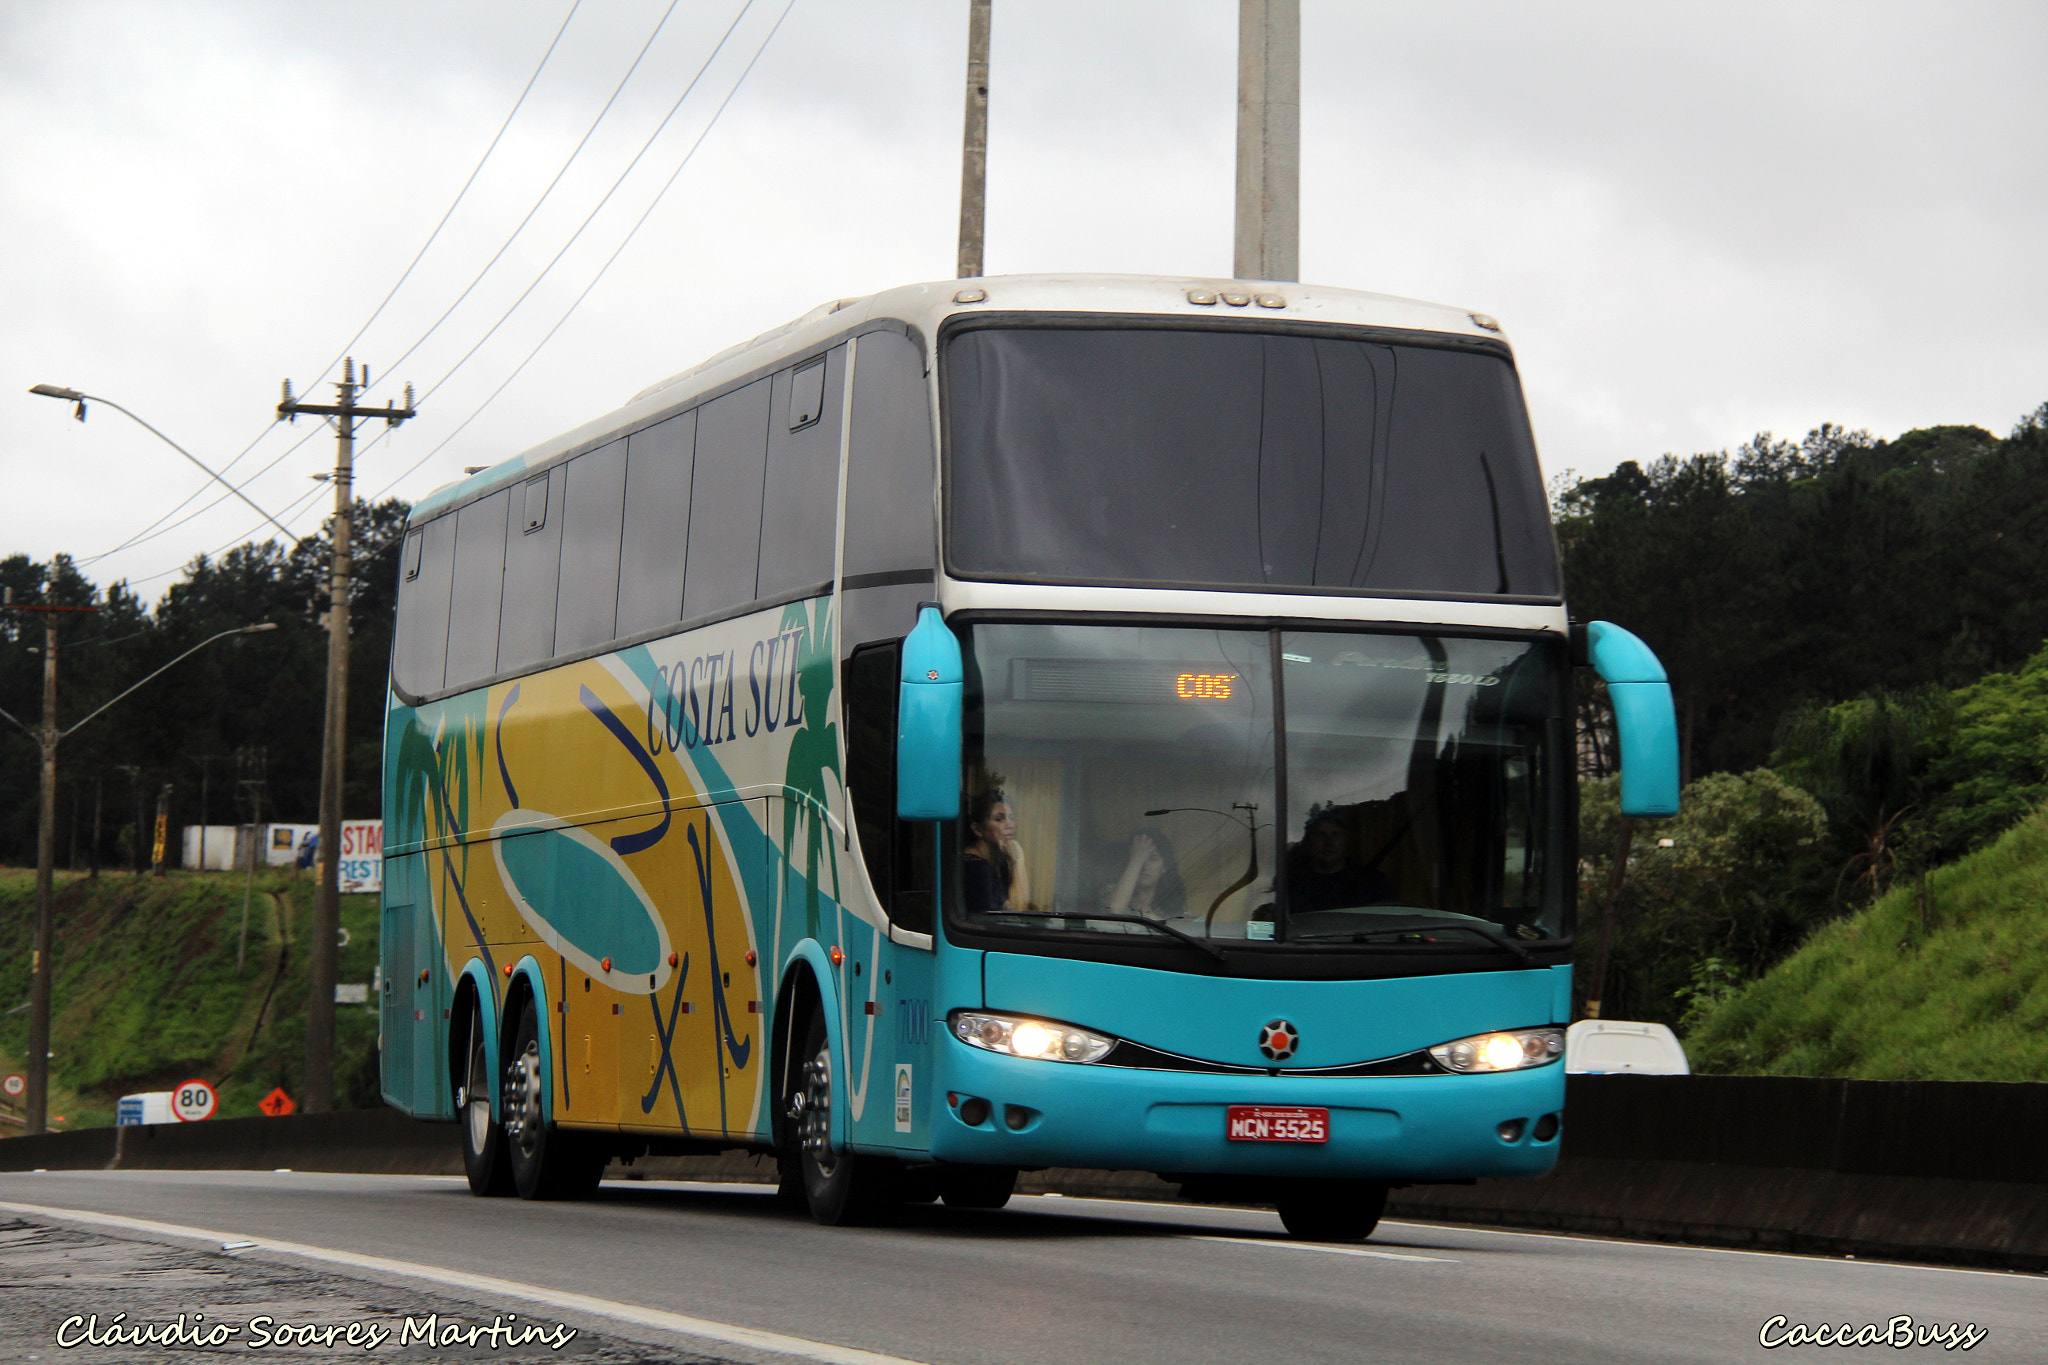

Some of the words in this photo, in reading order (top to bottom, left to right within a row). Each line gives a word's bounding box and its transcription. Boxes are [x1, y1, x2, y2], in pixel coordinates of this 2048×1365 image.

[648, 649, 736, 756] COSTA
[745, 631, 804, 738] SUL
[1177, 673, 1236, 699] COS
[900, 999, 930, 1045] 7000
[181, 1089, 208, 1107] 80
